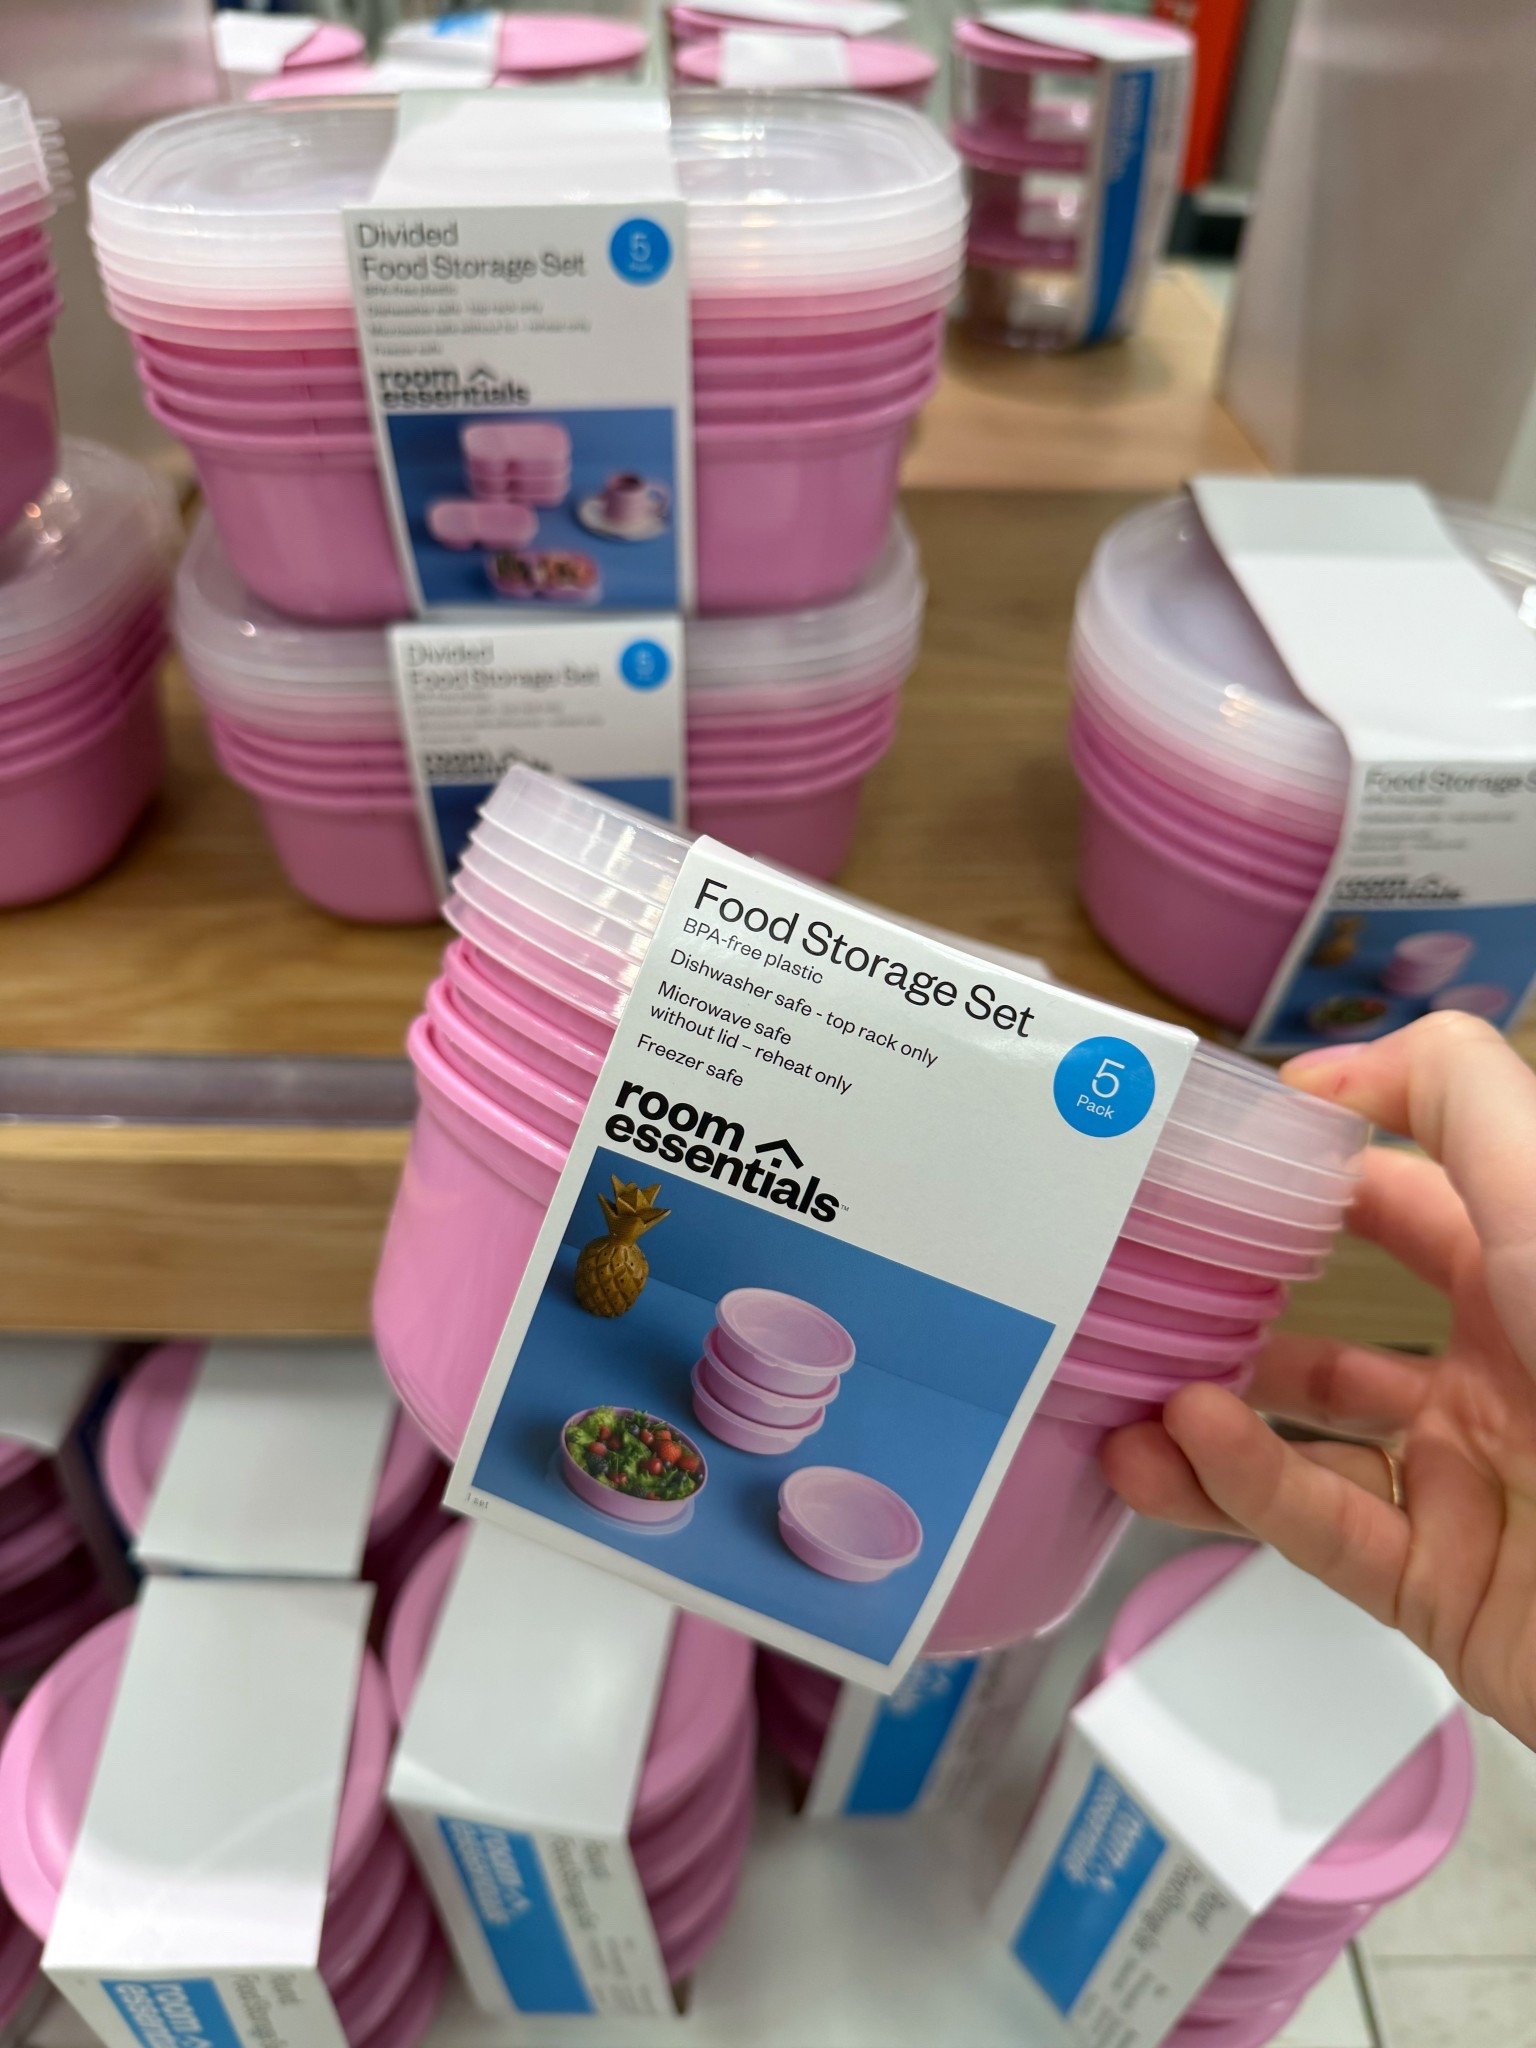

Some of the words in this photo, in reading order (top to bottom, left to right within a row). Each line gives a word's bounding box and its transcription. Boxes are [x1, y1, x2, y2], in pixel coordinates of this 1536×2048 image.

[357, 221, 459, 249] Divided
[629, 231, 651, 262] 5
[360, 255, 429, 282] Food
[431, 253, 538, 284] Storage
[540, 251, 587, 278] Set
[378, 368, 459, 391] room
[382, 382, 531, 408] essentials
[682, 917, 762, 960] BPA-free
[763, 953, 824, 984] plastic
[694, 877, 800, 945] Food
[802, 920, 958, 1007] Storage
[964, 983, 1035, 1038] Set
[657, 980, 752, 1030] Microwave
[753, 1021, 793, 1046] safe
[669, 948, 774, 1001] Dishwasher
[774, 992, 813, 1017] safe
[825, 1011, 856, 1035] top
[858, 1026, 900, 1052] rack
[900, 1042, 938, 1069] only
[636, 1033, 705, 1071] Freezer
[705, 1063, 744, 1087] safe
[650, 1005, 716, 1040] without
[716, 1027, 740, 1049] lid
[755, 1045, 813, 1079] reheat
[814, 1070, 853, 1096] only
[1091, 1057, 1126, 1098] 5
[614, 1080, 745, 1153] room
[1076, 1094, 1116, 1120] Pack
[605, 1113, 840, 1223] essentials
